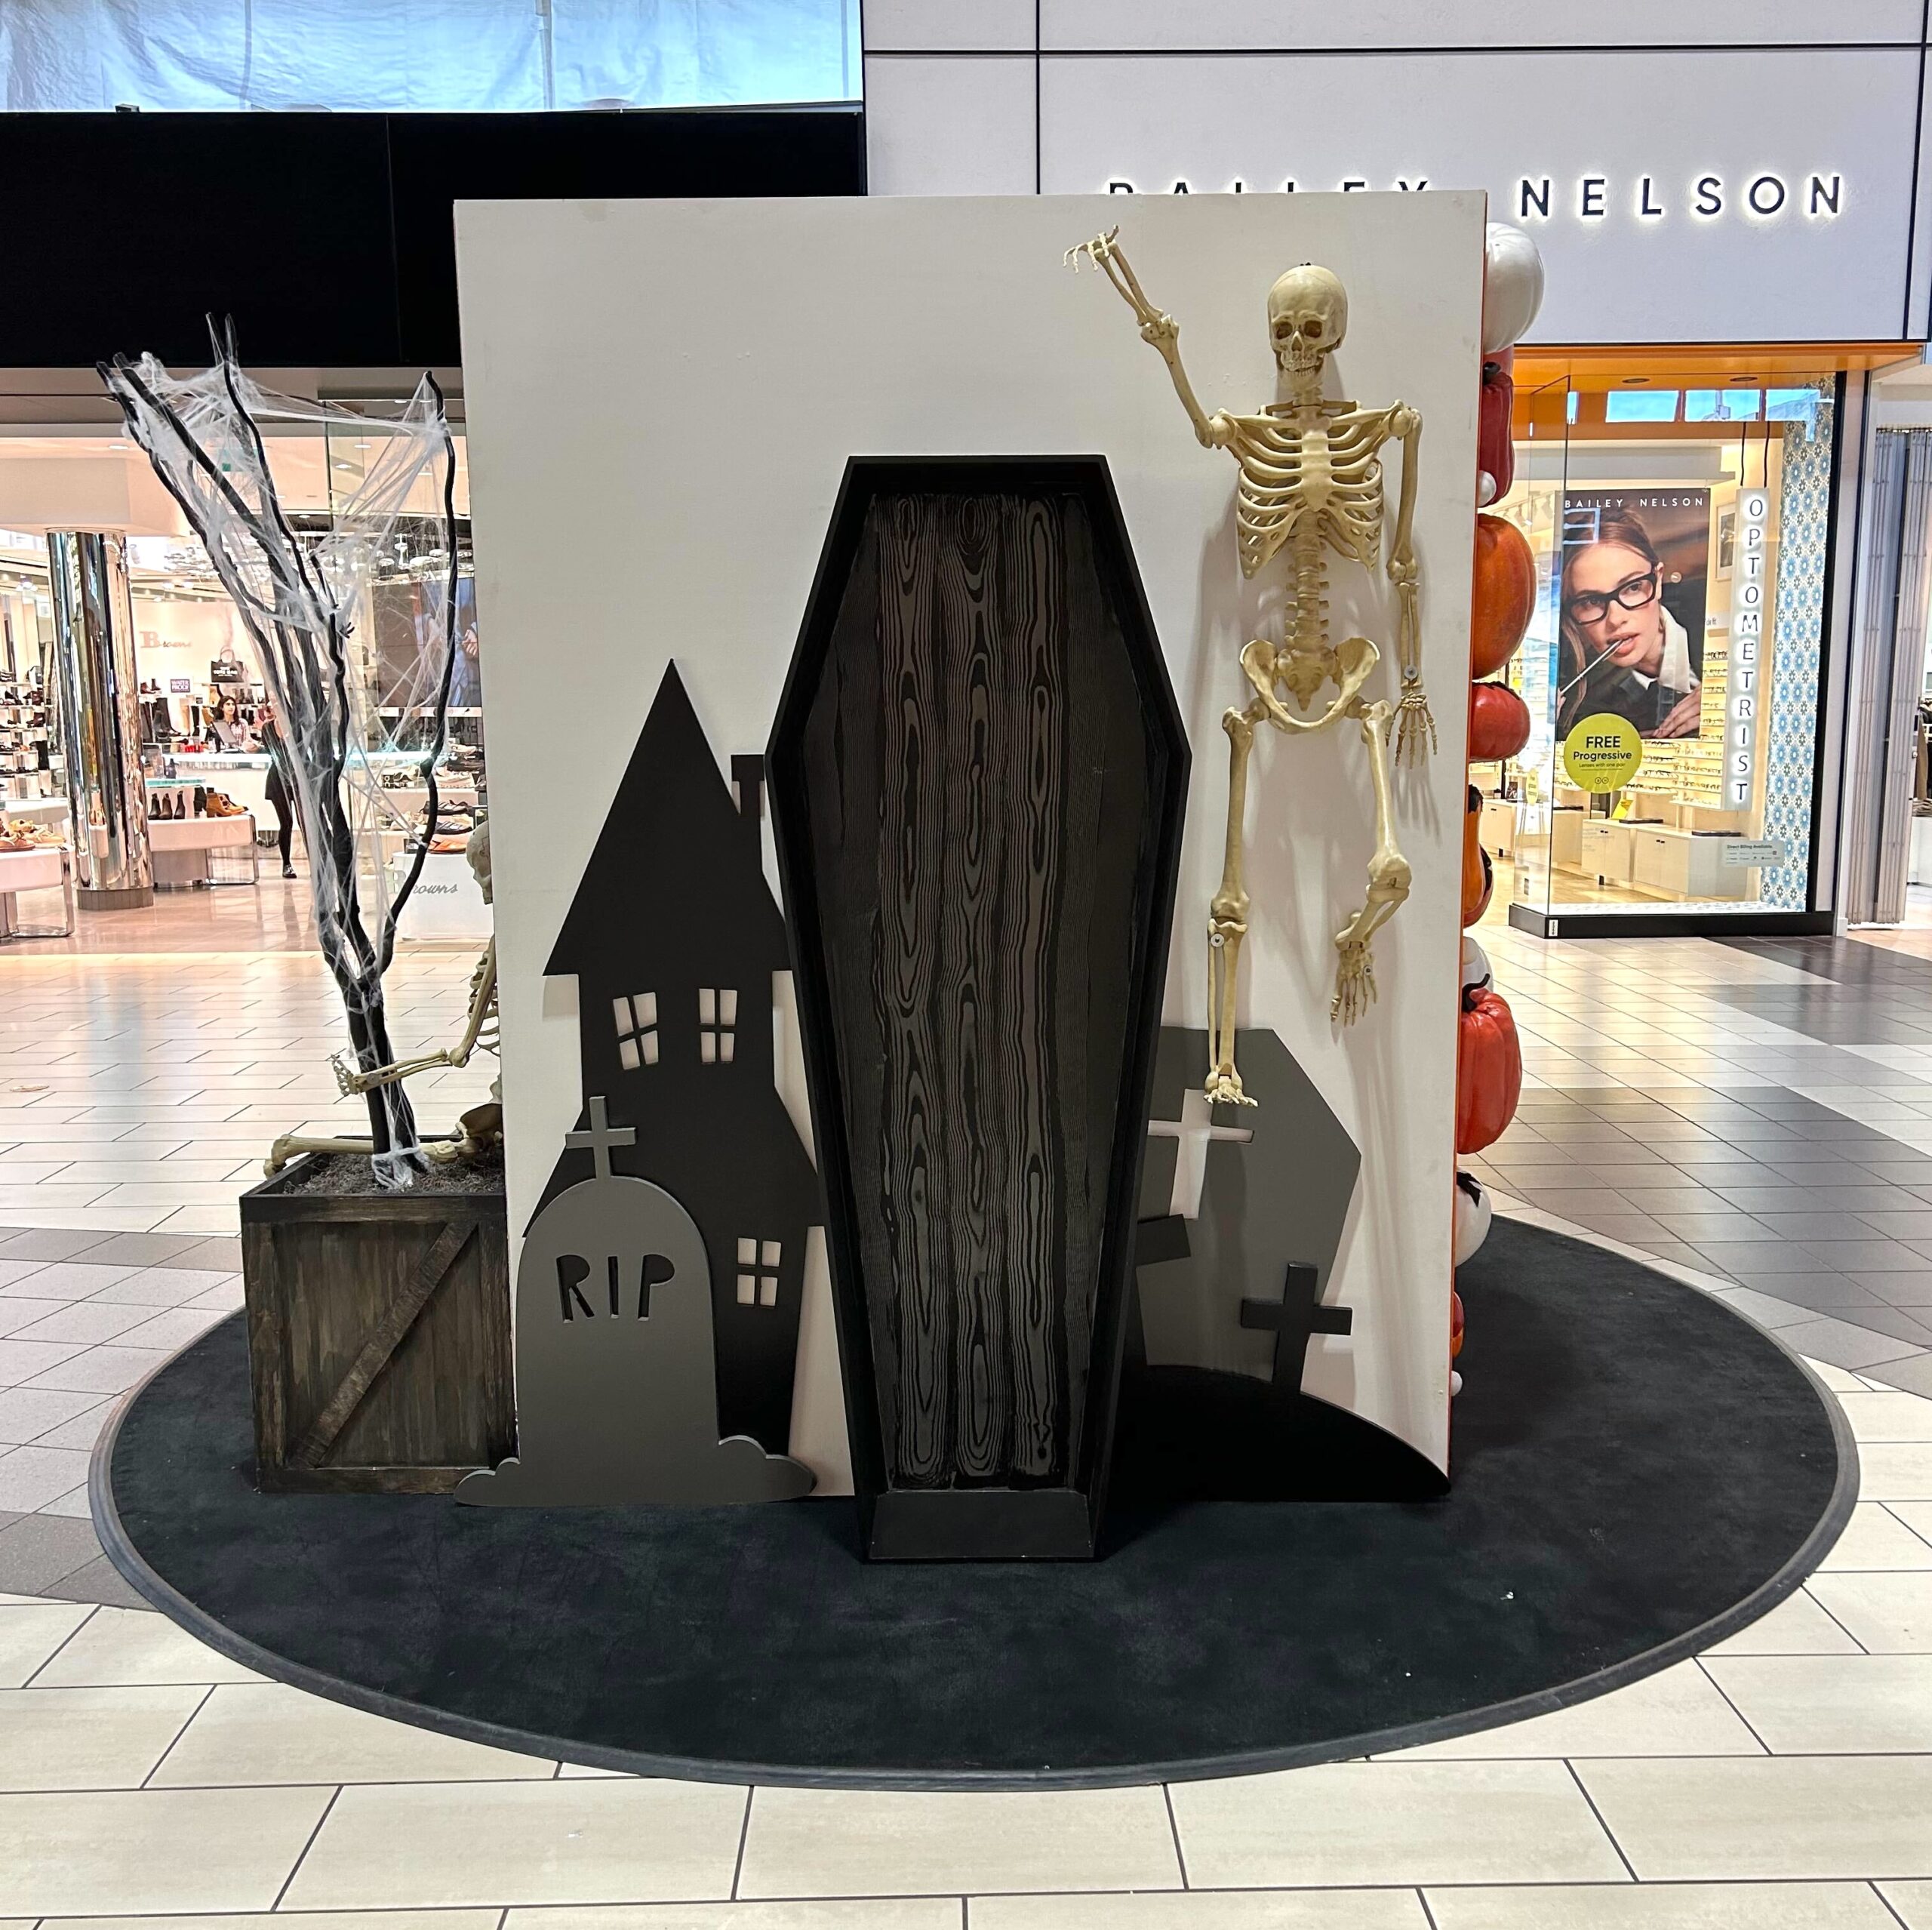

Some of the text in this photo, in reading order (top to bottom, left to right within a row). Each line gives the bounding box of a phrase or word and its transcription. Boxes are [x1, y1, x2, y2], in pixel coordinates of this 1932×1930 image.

[1521, 177, 1840, 217] NELSON
[1564, 497, 1703, 508] BAILEY NELSON
[1736, 499, 1764, 801] OPTOMETRIST
[1586, 736, 1621, 748] FREE
[1574, 750, 1632, 762] Progressive
[555, 1254, 675, 1322] RIP
